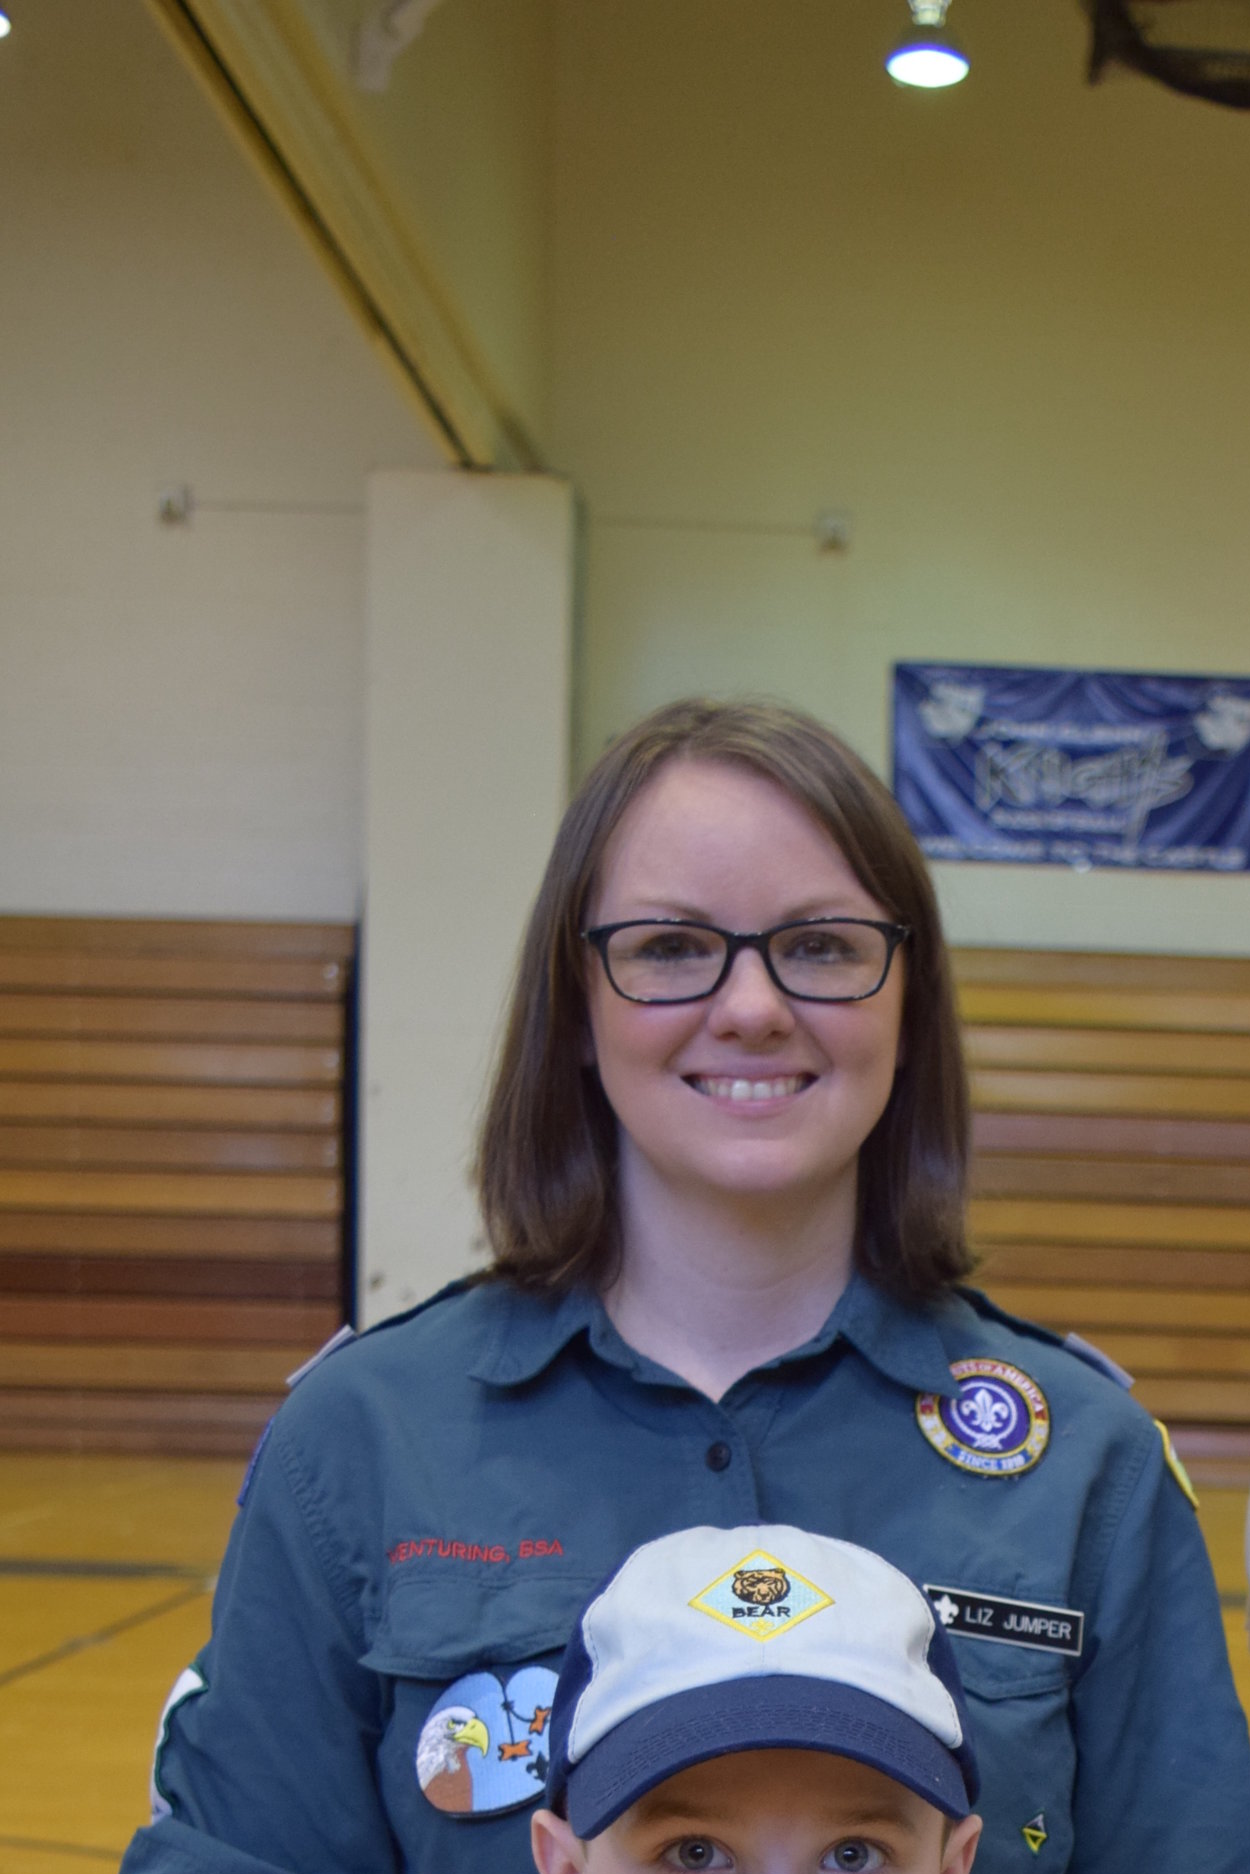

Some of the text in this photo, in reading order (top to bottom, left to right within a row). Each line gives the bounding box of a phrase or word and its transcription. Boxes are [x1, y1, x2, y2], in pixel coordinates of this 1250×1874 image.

[992, 1364, 1045, 1413] AMERICA
[518, 1539, 564, 1559] BSA
[731, 1605, 792, 1619] BEAR
[964, 1605, 1072, 1640] LIZ JUMPER
